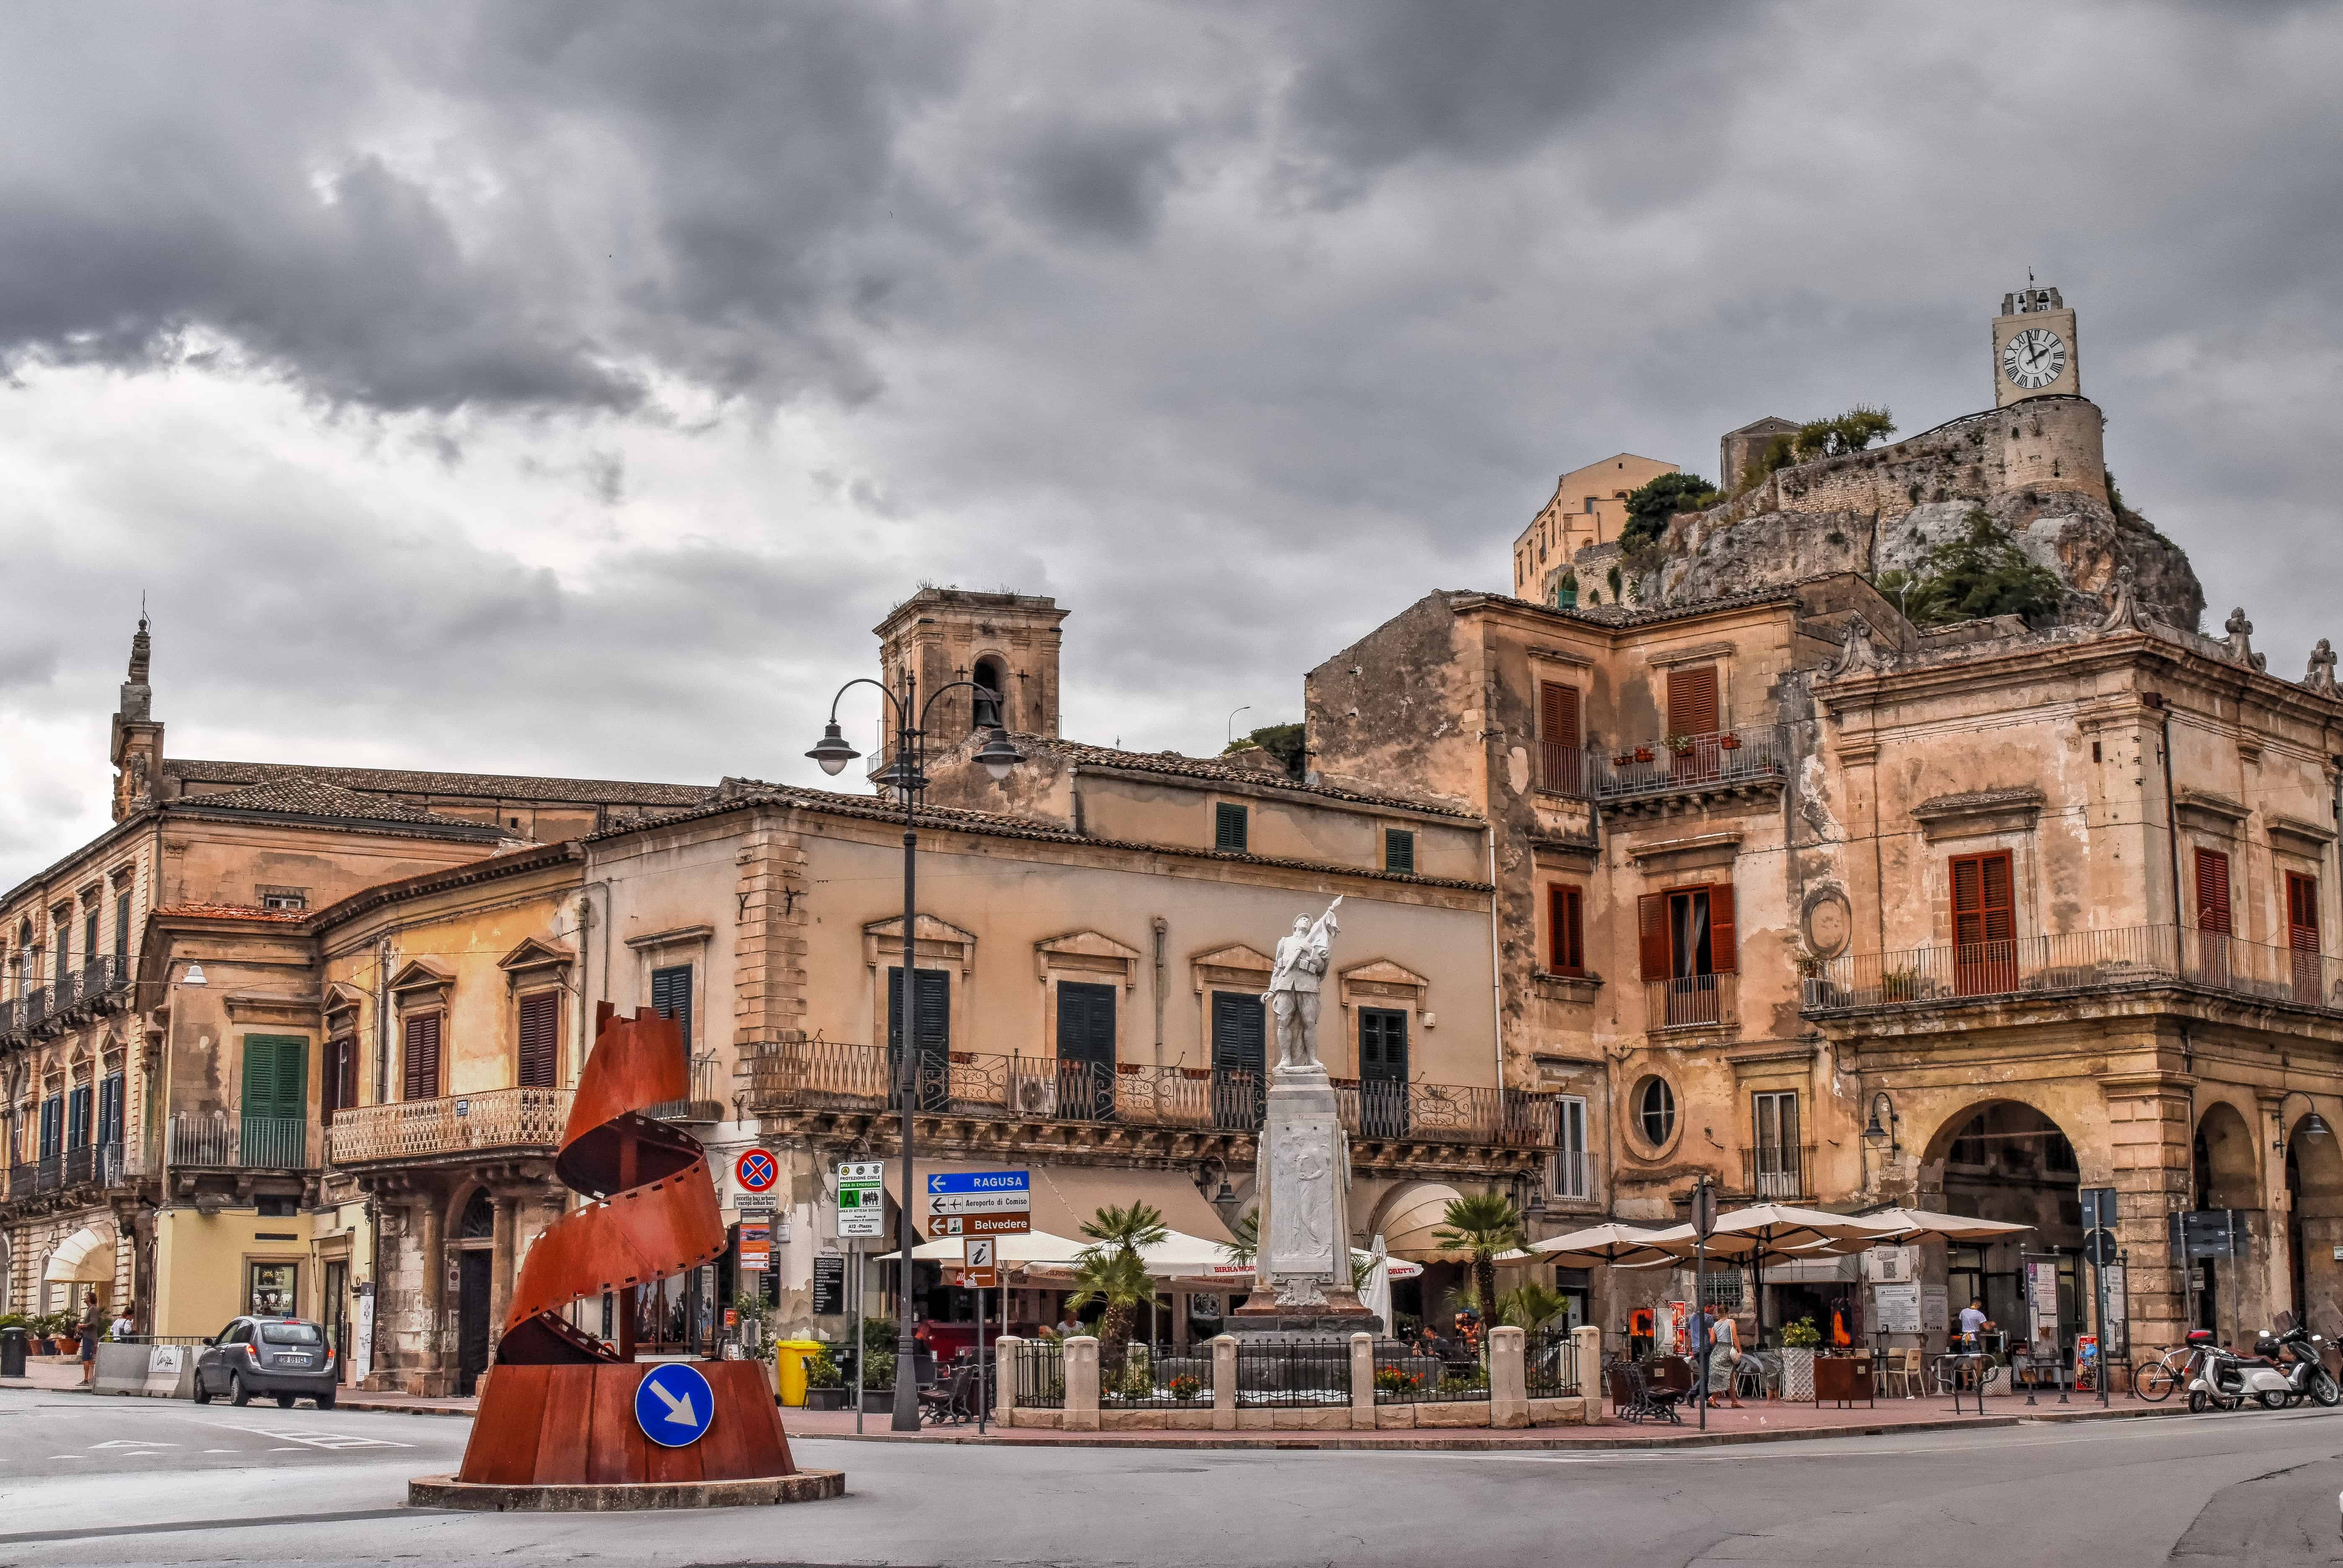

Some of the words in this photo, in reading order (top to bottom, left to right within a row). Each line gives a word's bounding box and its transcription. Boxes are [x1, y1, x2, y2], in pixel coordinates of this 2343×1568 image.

[2015, 334, 2026, 348] XI
[2043, 331, 2051, 342] I
[2049, 338, 2061, 349] II
[2007, 345, 2019, 354] X
[2053, 351, 2064, 359] III
[2004, 356, 2015, 366] IX
[2006, 365, 2020, 380] VIII
[2045, 372, 2054, 383] V
[2016, 375, 2028, 387] VII
[2033, 377, 2042, 387] VI
[974, 1177, 1022, 1187] RAGUSA
[843, 1190, 857, 1207] A
[966, 1199, 995, 1207] Aeroporto
[975, 1219, 1027, 1230] Belvedere
